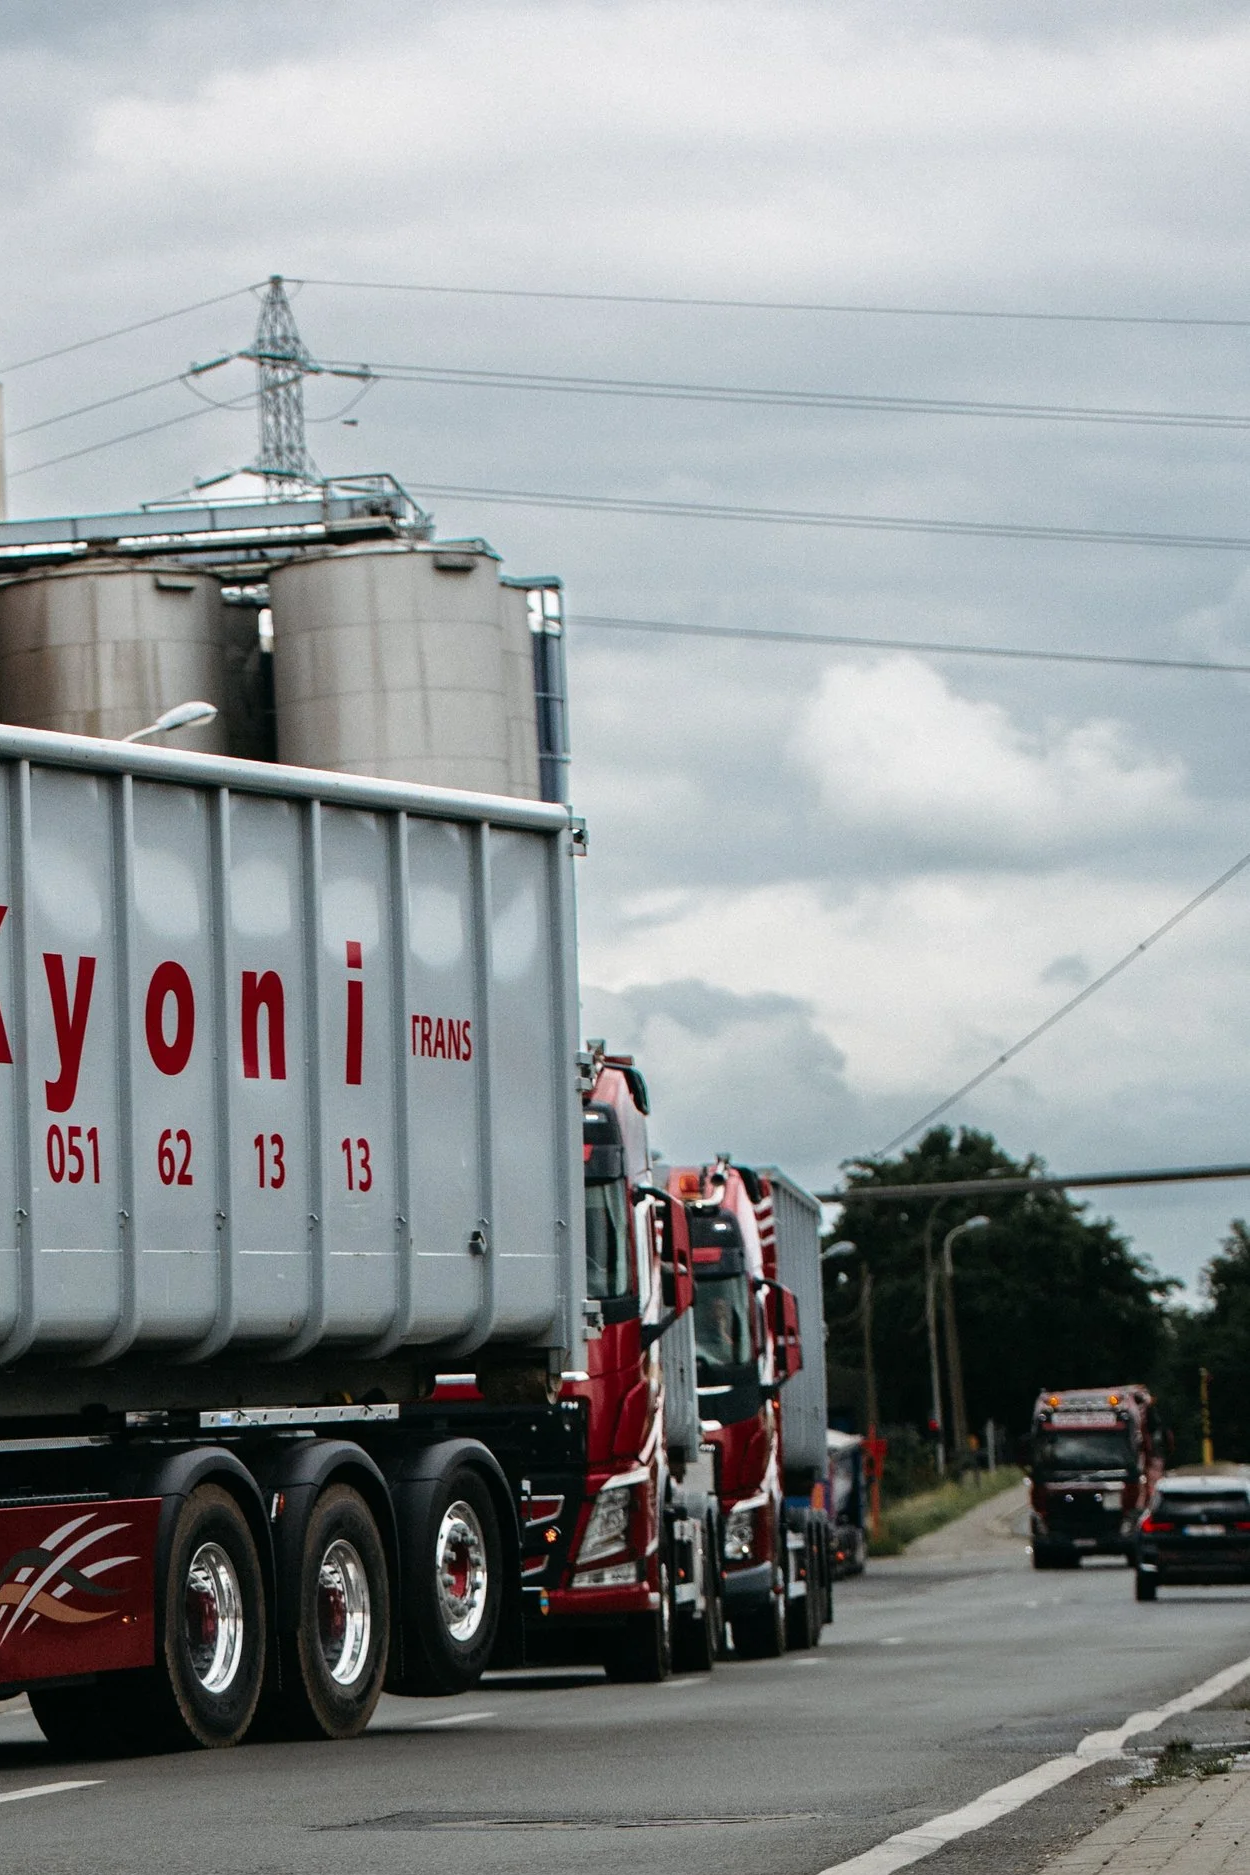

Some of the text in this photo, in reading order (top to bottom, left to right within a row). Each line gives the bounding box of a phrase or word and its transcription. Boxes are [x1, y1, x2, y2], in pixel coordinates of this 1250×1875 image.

[411, 1014, 473, 1062] TRANS
[46, 1123, 373, 1193] 051 62 13 13
